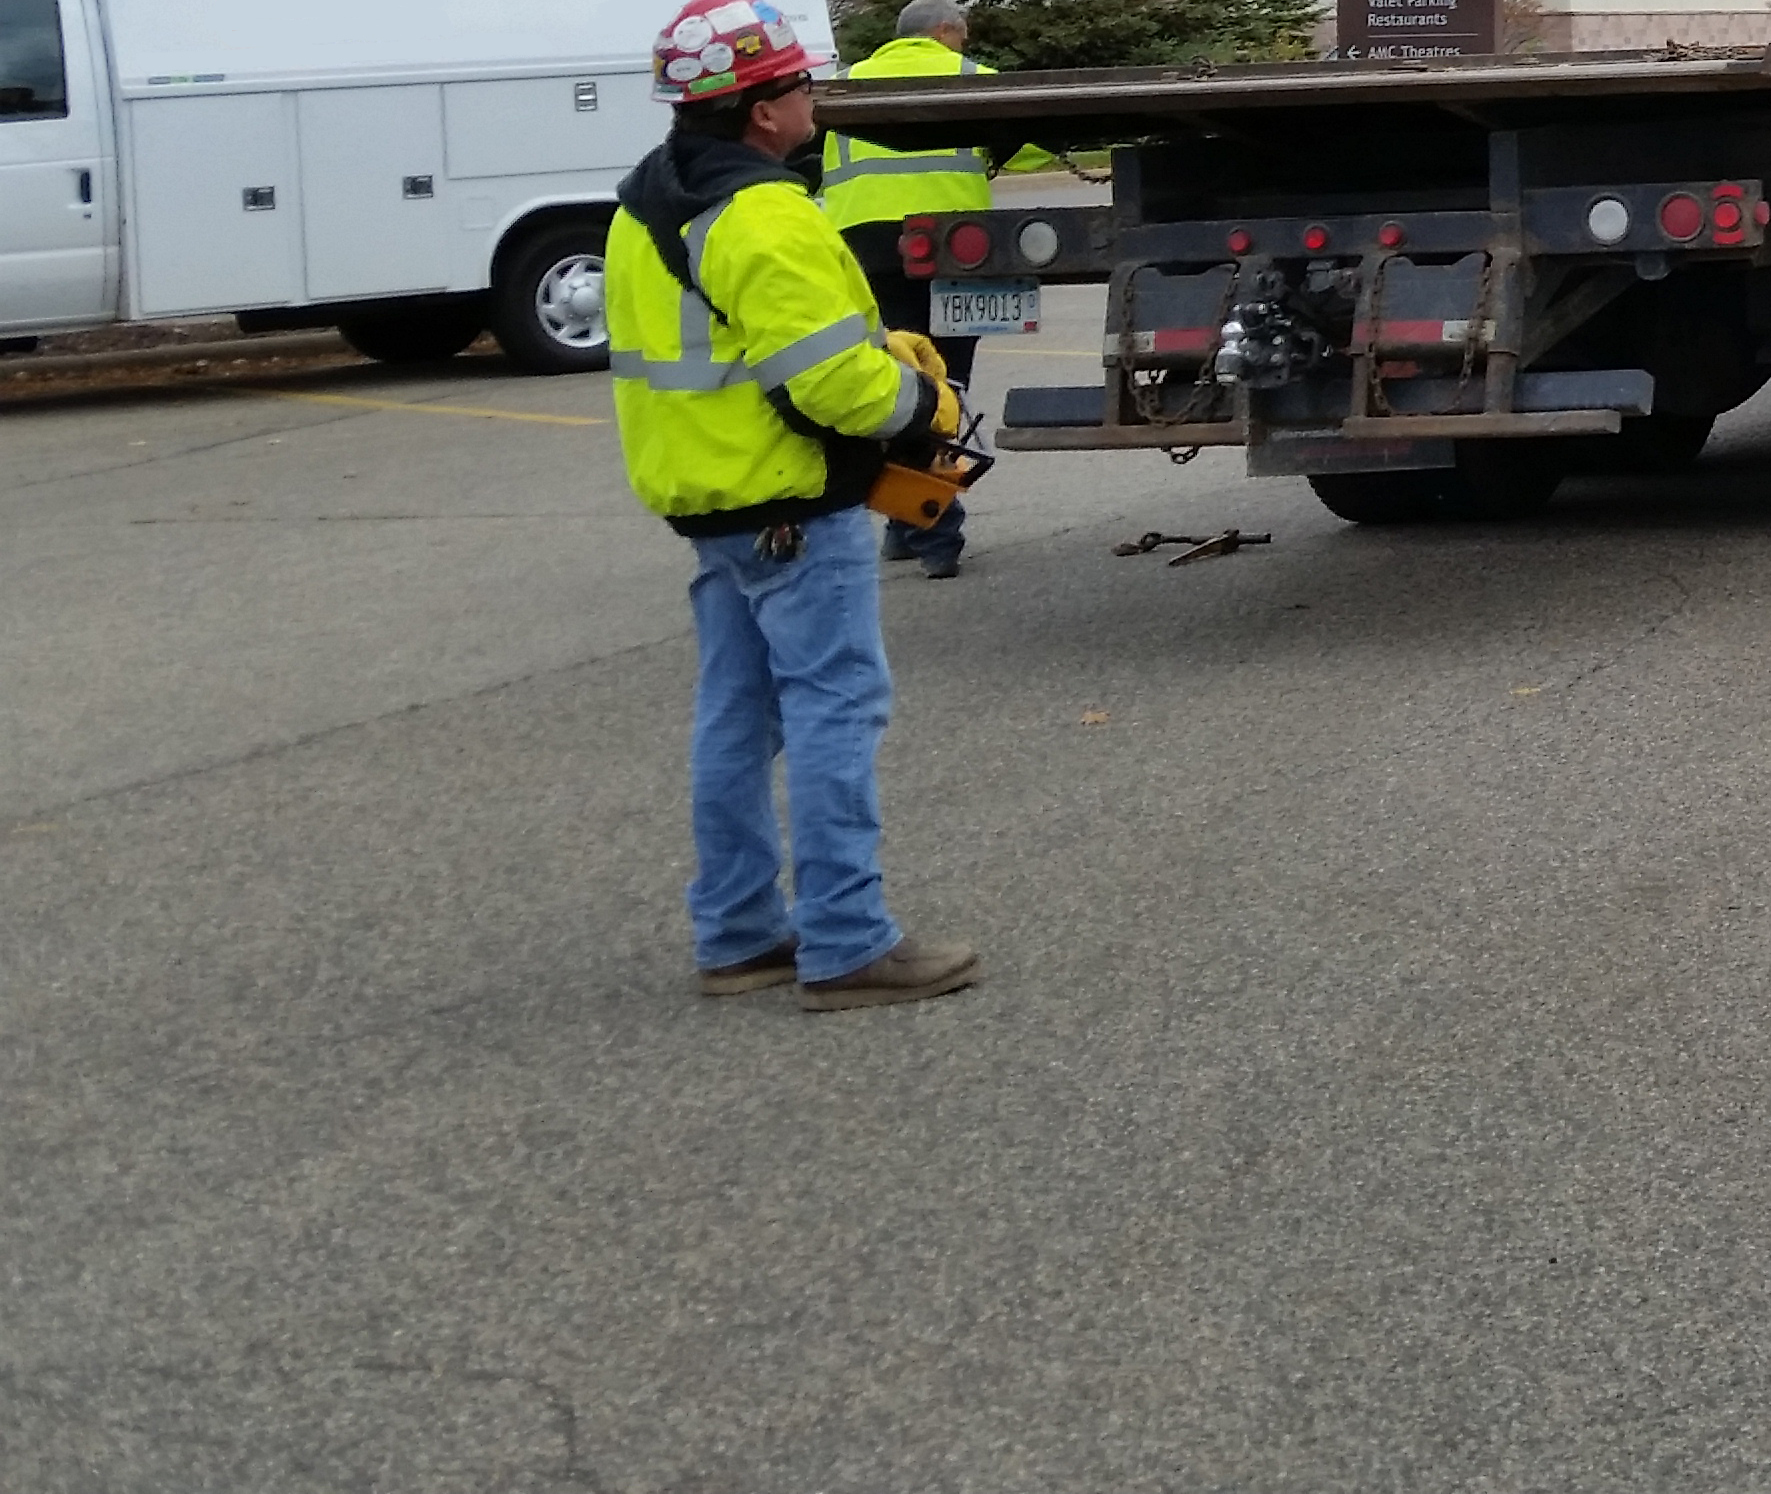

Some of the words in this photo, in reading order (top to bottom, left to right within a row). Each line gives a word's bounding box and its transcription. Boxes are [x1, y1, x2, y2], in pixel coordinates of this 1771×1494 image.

[1367, 12, 1448, 27] Restaurants
[1368, 46, 1397, 59] AMC
[1401, 44, 1462, 58] Theatres
[941, 293, 1022, 323] YBK9013
